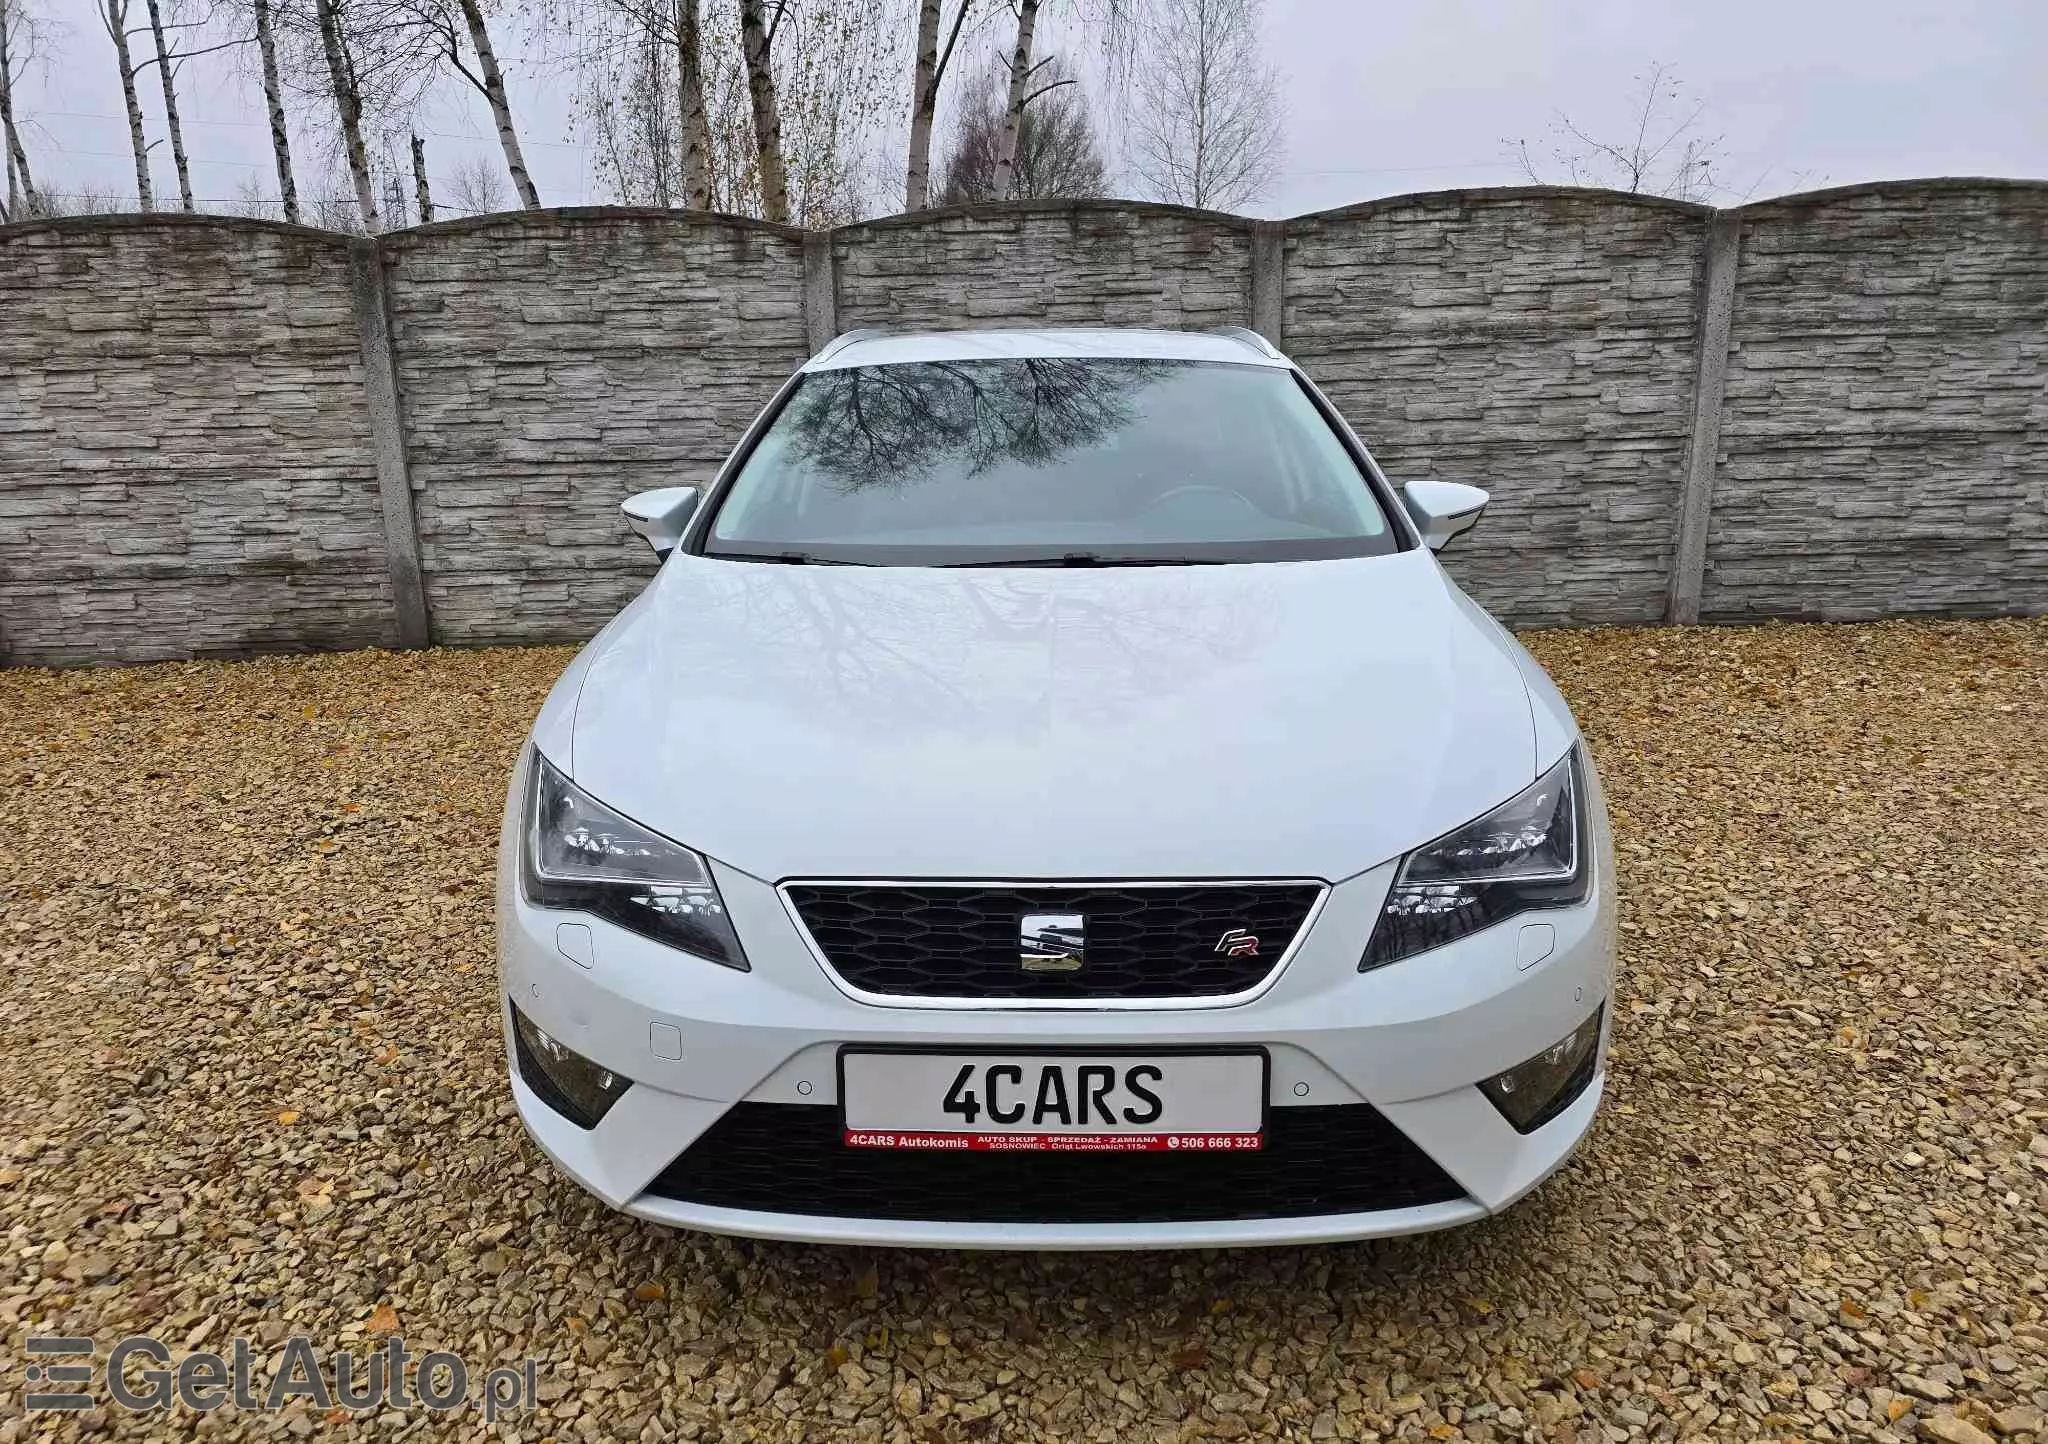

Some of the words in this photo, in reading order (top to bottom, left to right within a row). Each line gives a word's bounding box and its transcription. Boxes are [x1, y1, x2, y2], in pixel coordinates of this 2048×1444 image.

[942, 1064, 1164, 1125] 4CARS
[849, 1134, 895, 1146] 4CARS
[898, 1136, 969, 1148] Autokomis
[1181, 1137, 1205, 1148] 506
[1208, 1137, 1232, 1148] 666
[1235, 1137, 1258, 1148] 323
